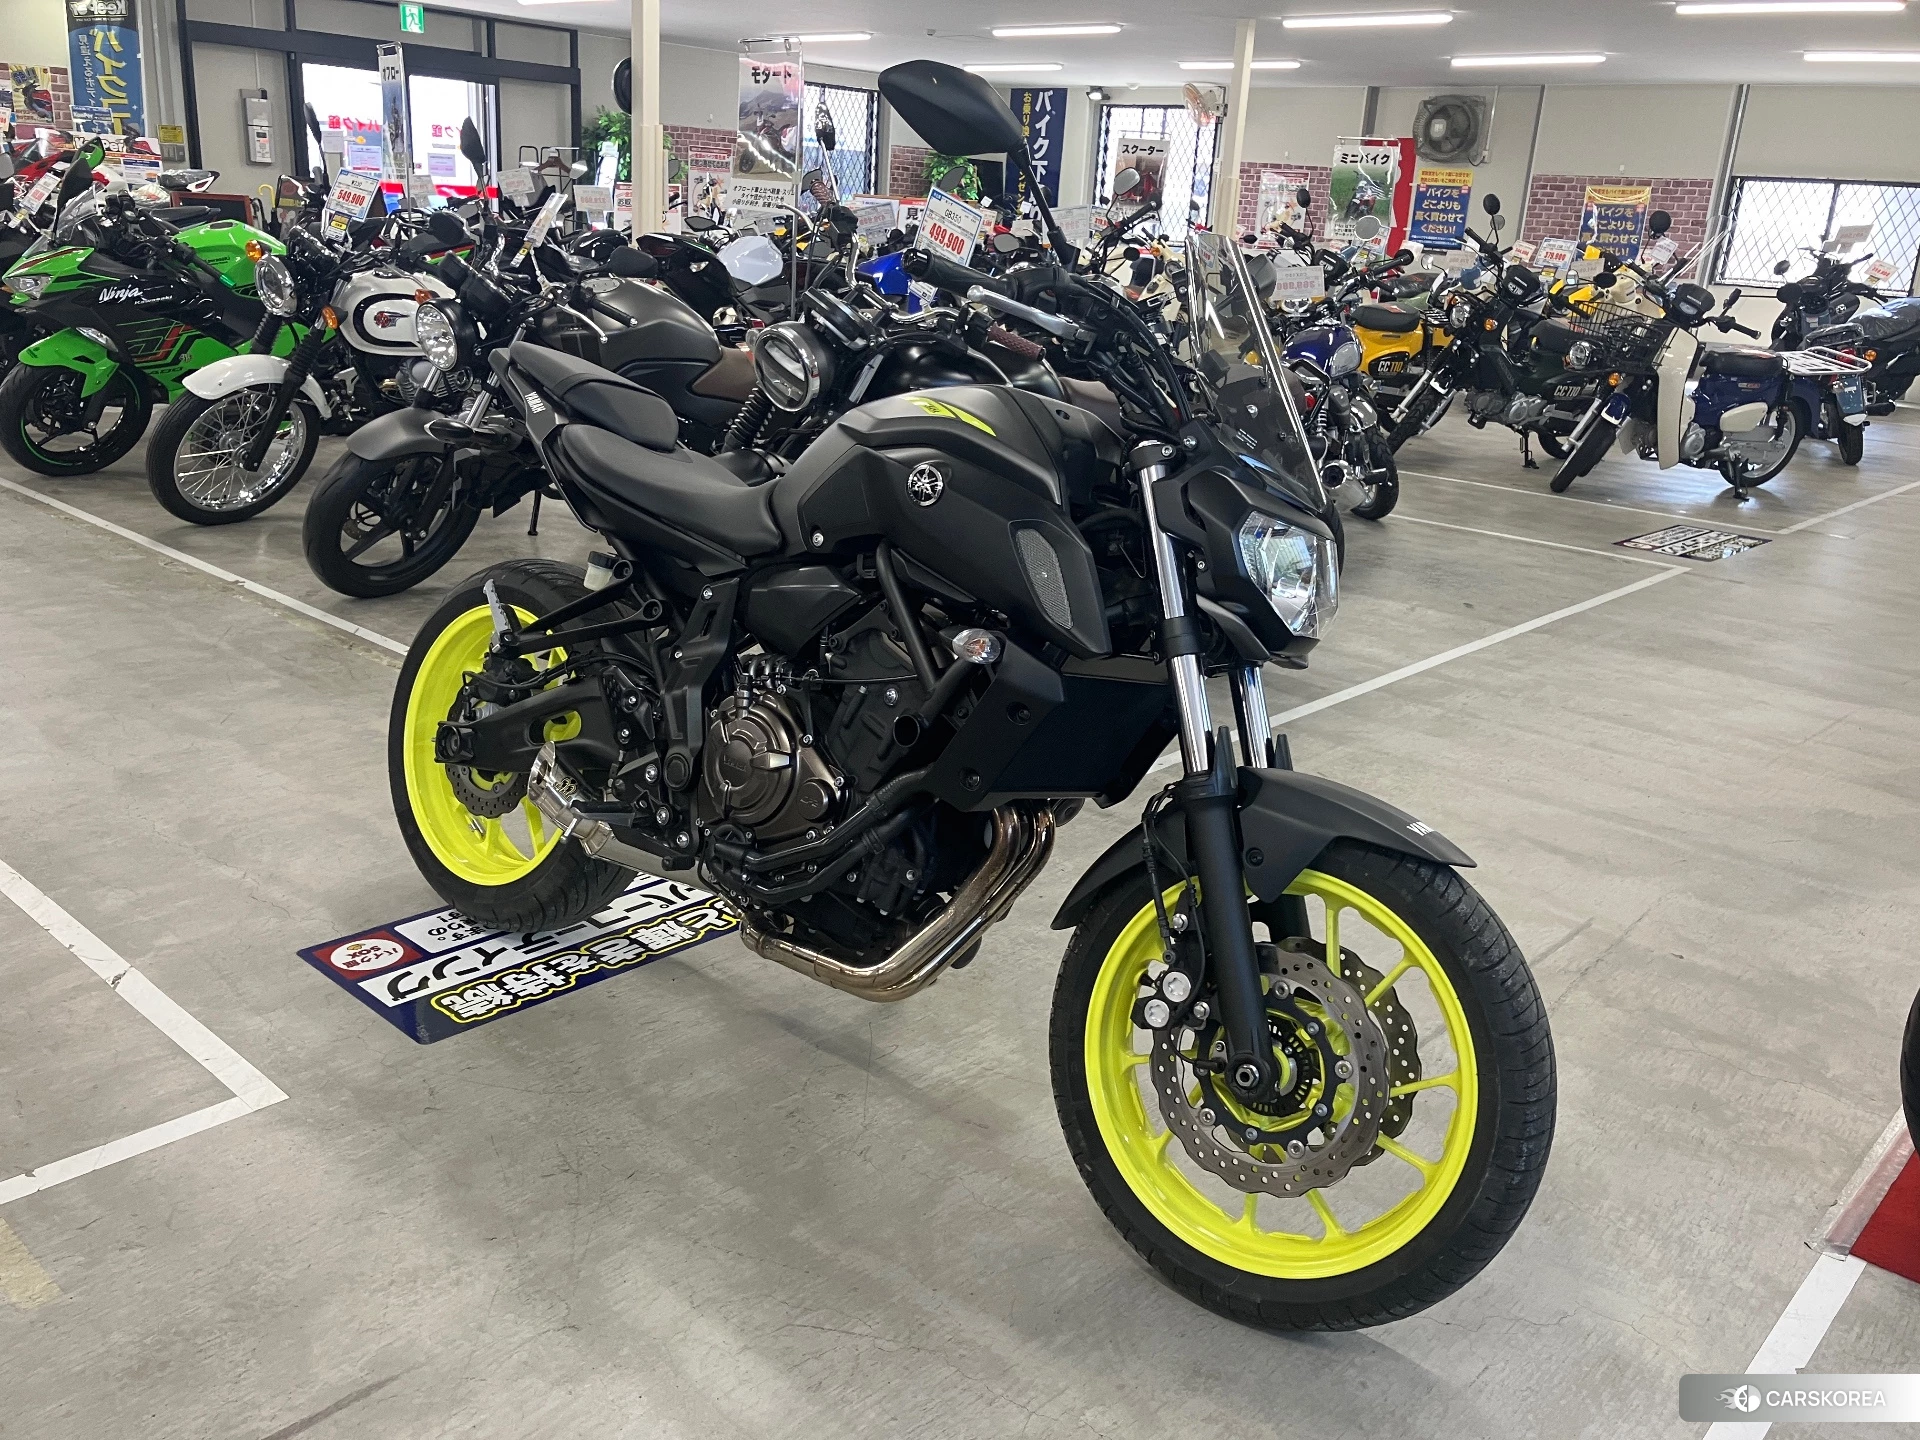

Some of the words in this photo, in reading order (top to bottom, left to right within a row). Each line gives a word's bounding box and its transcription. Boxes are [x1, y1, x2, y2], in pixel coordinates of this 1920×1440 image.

[1122, 144, 1164, 155] スクーター
[1340, 152, 1391, 165] ミニバイク
[1427, 187, 1460, 198] バイクを
[1422, 199, 1461, 210] どこよりも
[1415, 211, 1465, 223] 高く買わせて
[929, 222, 965, 256] 499,900
[98, 284, 143, 303] Ninja
